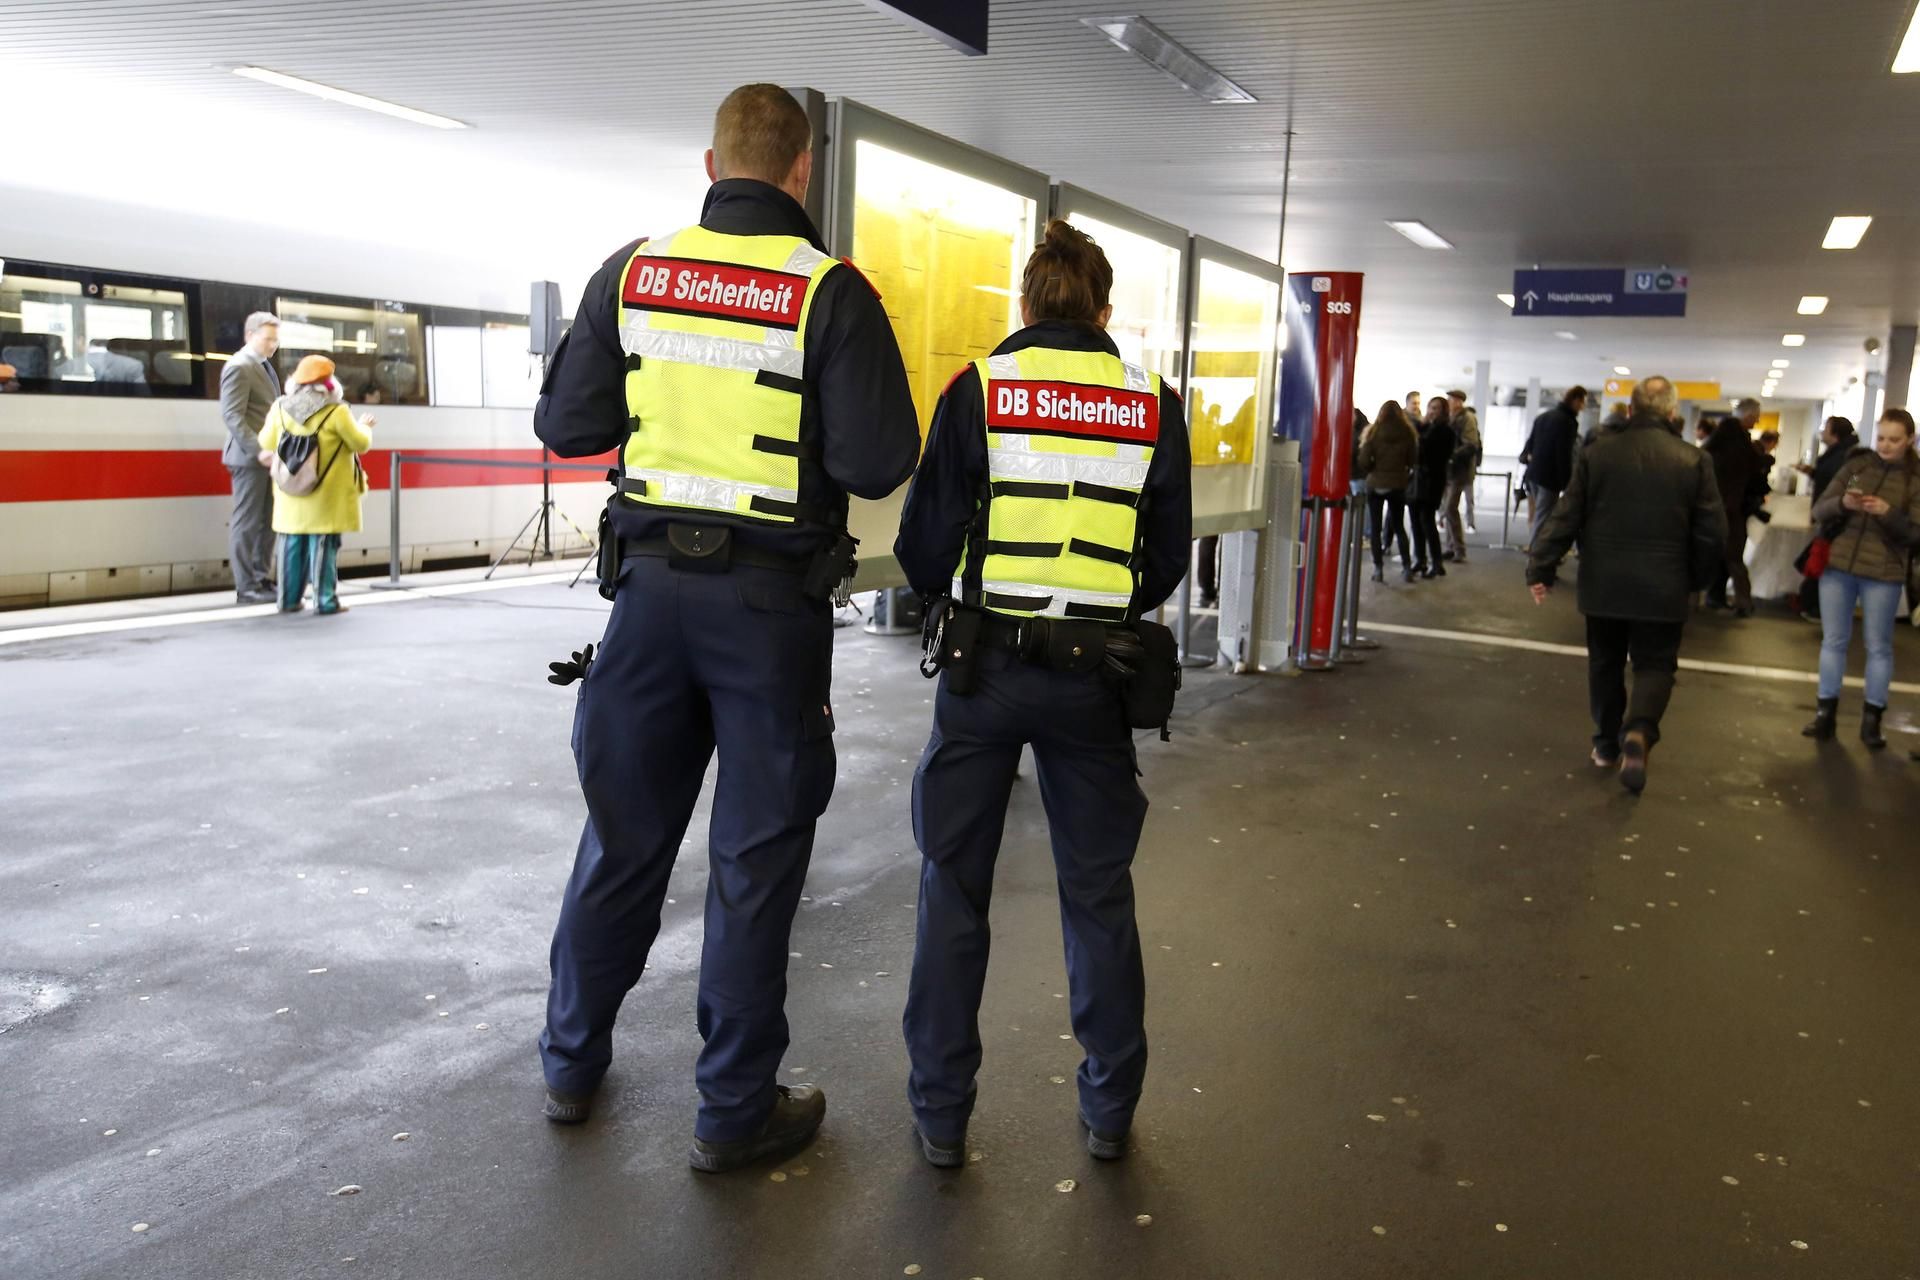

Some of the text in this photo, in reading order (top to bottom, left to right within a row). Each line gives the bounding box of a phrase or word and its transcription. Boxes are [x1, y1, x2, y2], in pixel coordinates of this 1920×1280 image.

[636, 265, 793, 315] DB Sicherheit
[1637, 274, 1651, 290] U
[1547, 291, 1613, 304] Hauptausgang
[1326, 301, 1352, 315] SOS
[997, 387, 1146, 429] DB Sicherheit
